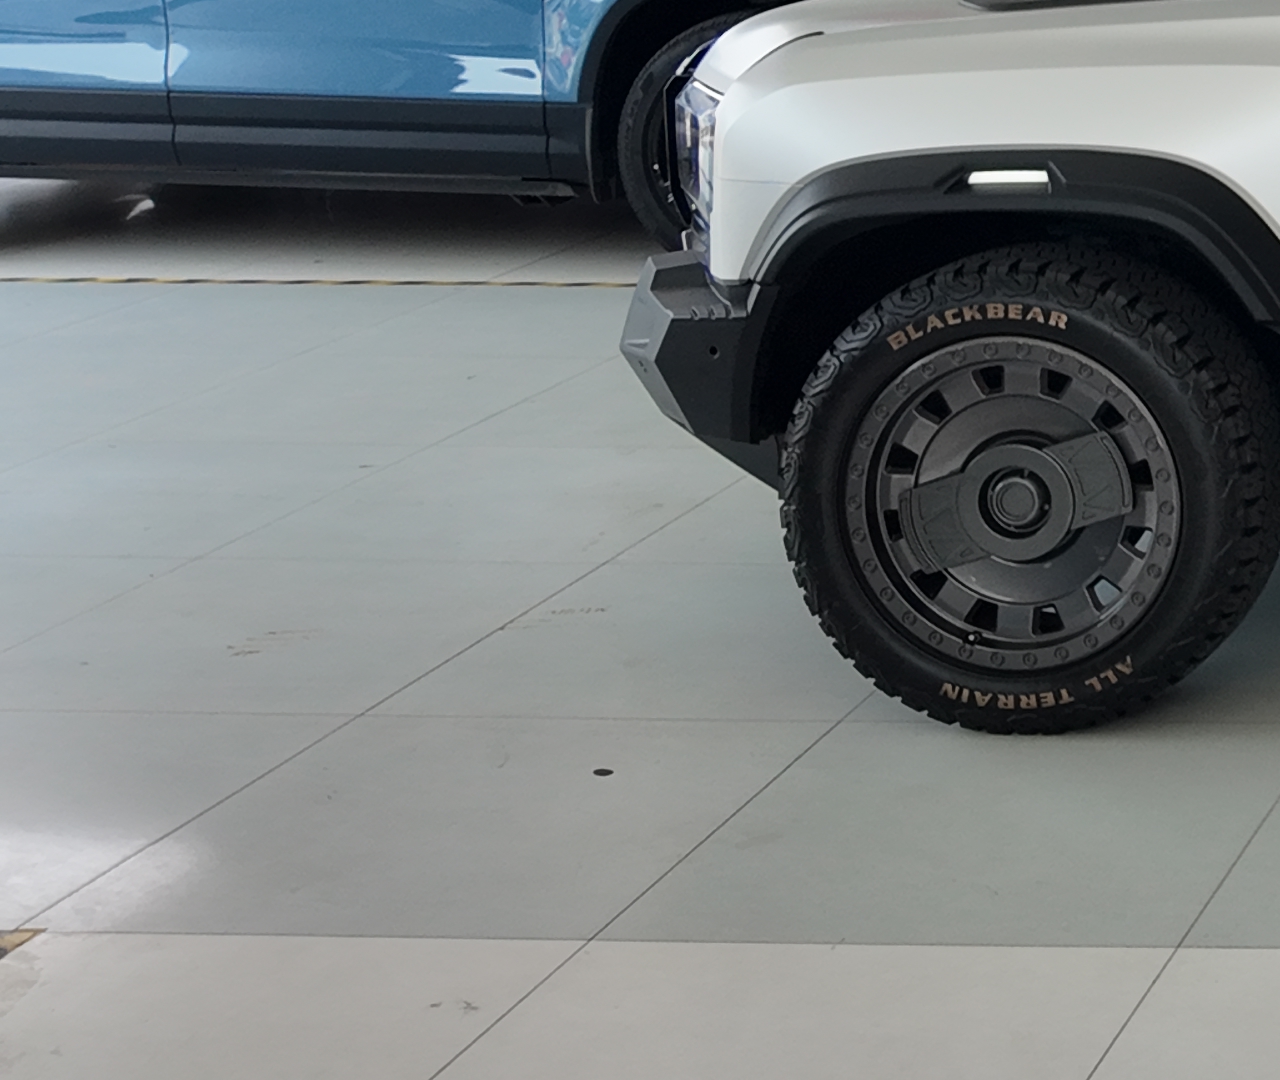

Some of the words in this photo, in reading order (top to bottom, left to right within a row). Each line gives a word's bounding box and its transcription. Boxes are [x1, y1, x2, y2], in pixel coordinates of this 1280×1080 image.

[885, 302, 1069, 351] BLACKBEAR
[1084, 655, 1135, 692] ALL
[940, 681, 1075, 709] TERRAIN
